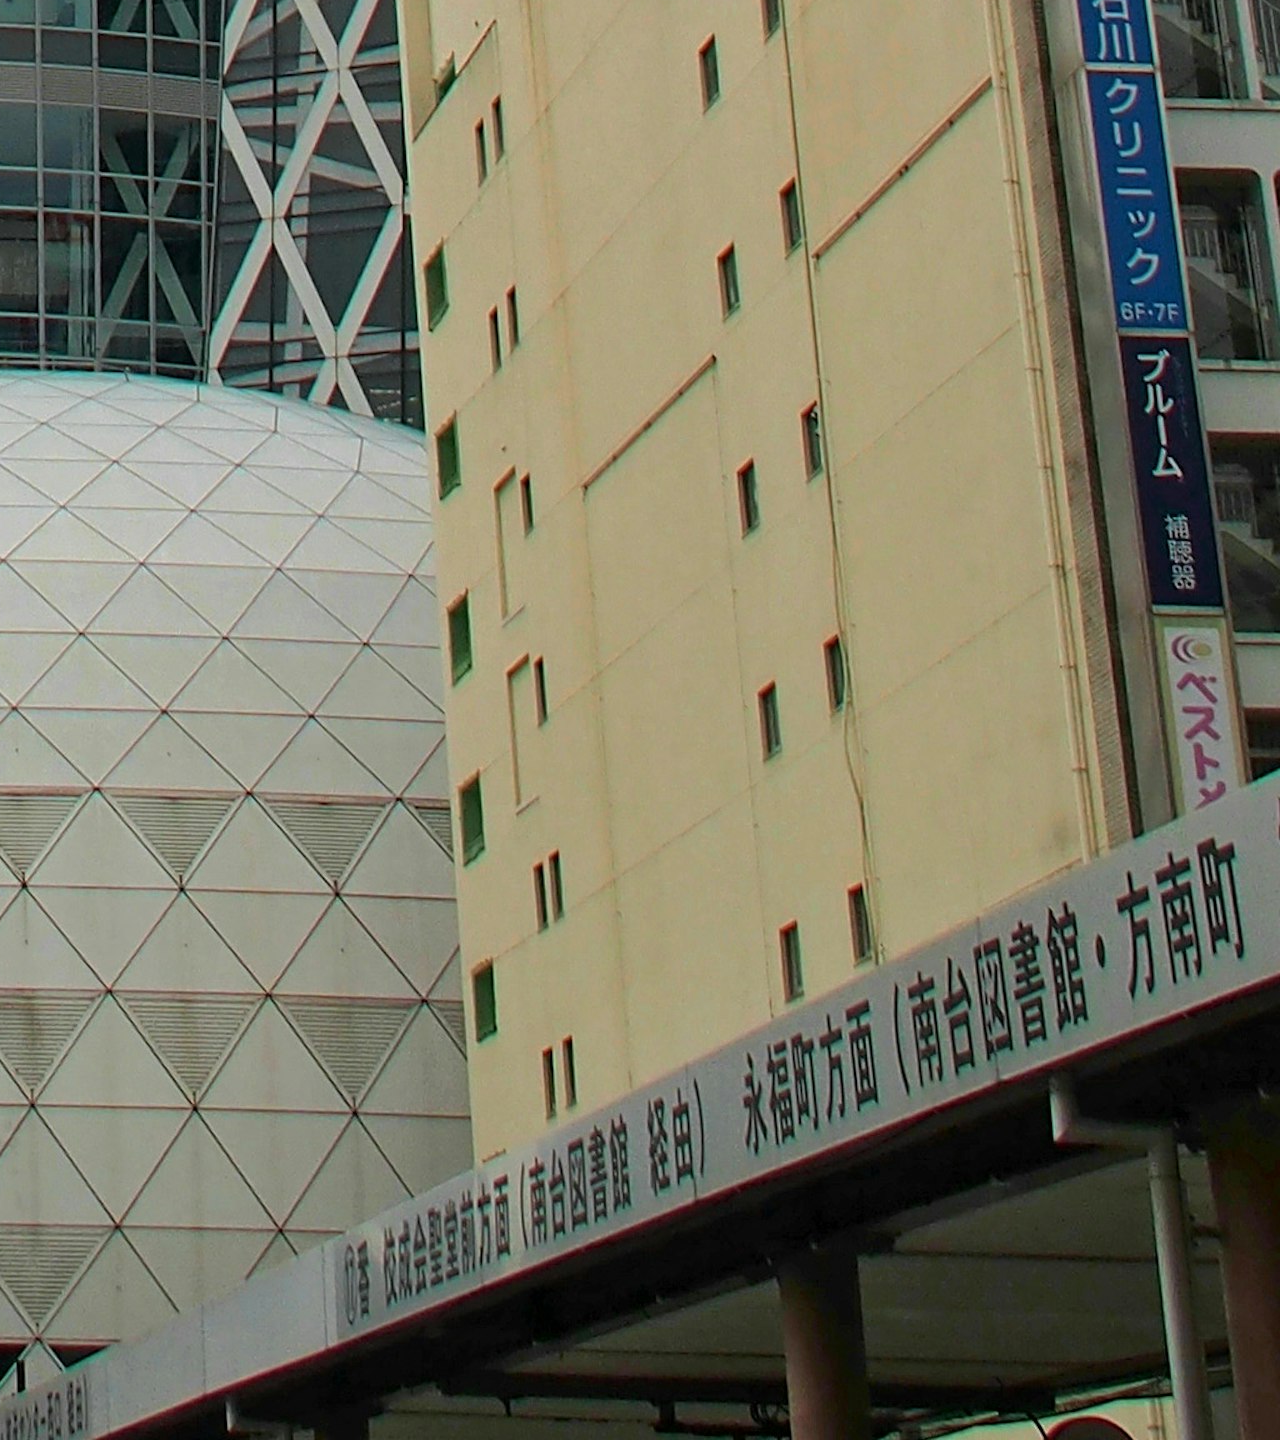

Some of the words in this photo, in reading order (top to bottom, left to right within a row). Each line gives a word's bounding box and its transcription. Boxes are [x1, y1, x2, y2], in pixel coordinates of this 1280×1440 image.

[1137, 349, 1183, 479] ブルーム
[1164, 514, 1195, 590] 補聴器
